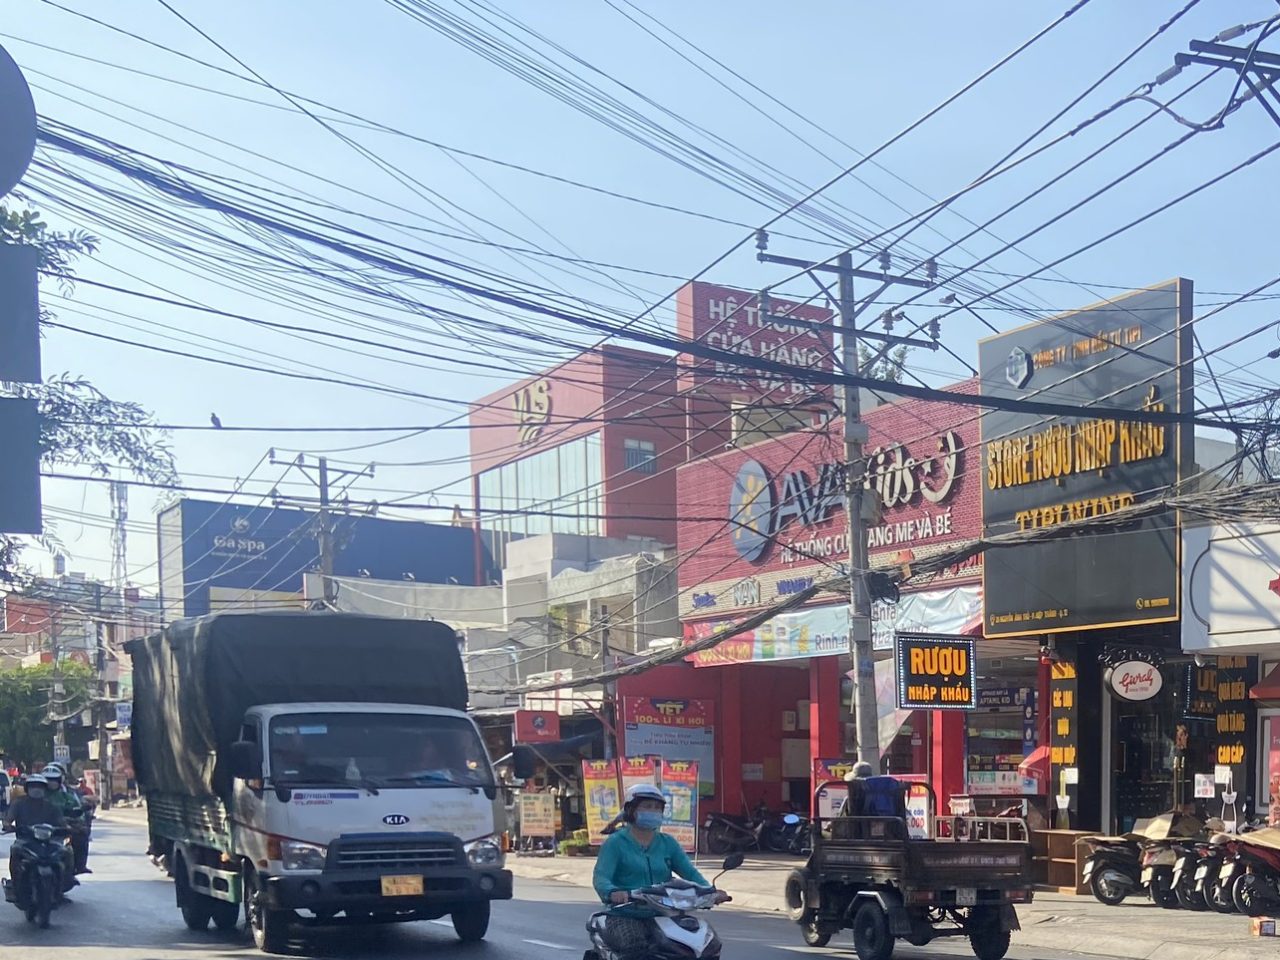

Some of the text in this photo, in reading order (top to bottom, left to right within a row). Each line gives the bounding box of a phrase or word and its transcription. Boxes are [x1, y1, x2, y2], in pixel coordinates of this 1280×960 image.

[986, 435, 1030, 490] STORE
[914, 511, 934, 538] VÀ
[934, 507, 952, 534] BÉ
[734, 577, 761, 606] NAN
[814, 633, 838, 651] Rinh
[910, 645, 967, 682] RƯỢU
[908, 682, 969, 703] NHẬP KHẨU
[1118, 668, 1154, 694] Givral
[634, 714, 660, 725] 100%
[656, 700, 685, 716] TẾT
[386, 816, 407, 824] KIA
